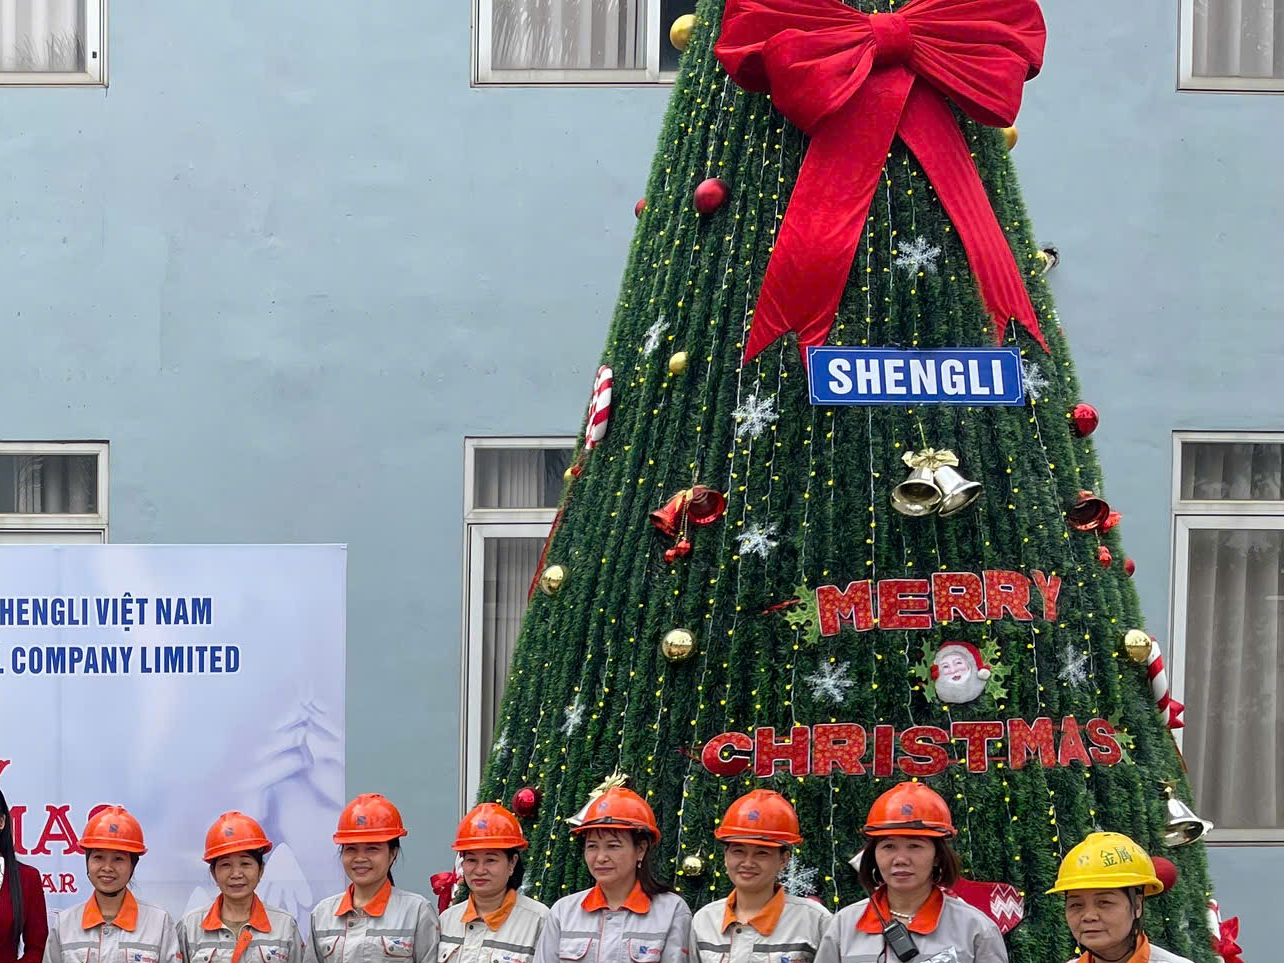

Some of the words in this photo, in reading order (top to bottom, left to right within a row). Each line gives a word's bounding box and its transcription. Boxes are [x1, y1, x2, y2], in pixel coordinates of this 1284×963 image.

[828, 358, 1005, 396] SHENGLI
[95, 592, 149, 632] VIỆT
[155, 597, 212, 625] NAM
[817, 569, 1062, 637] MERRY
[11, 646, 133, 675] COMPANY
[140, 645, 240, 674] LIMITED
[701, 715, 1123, 777] CHRISTMAS
